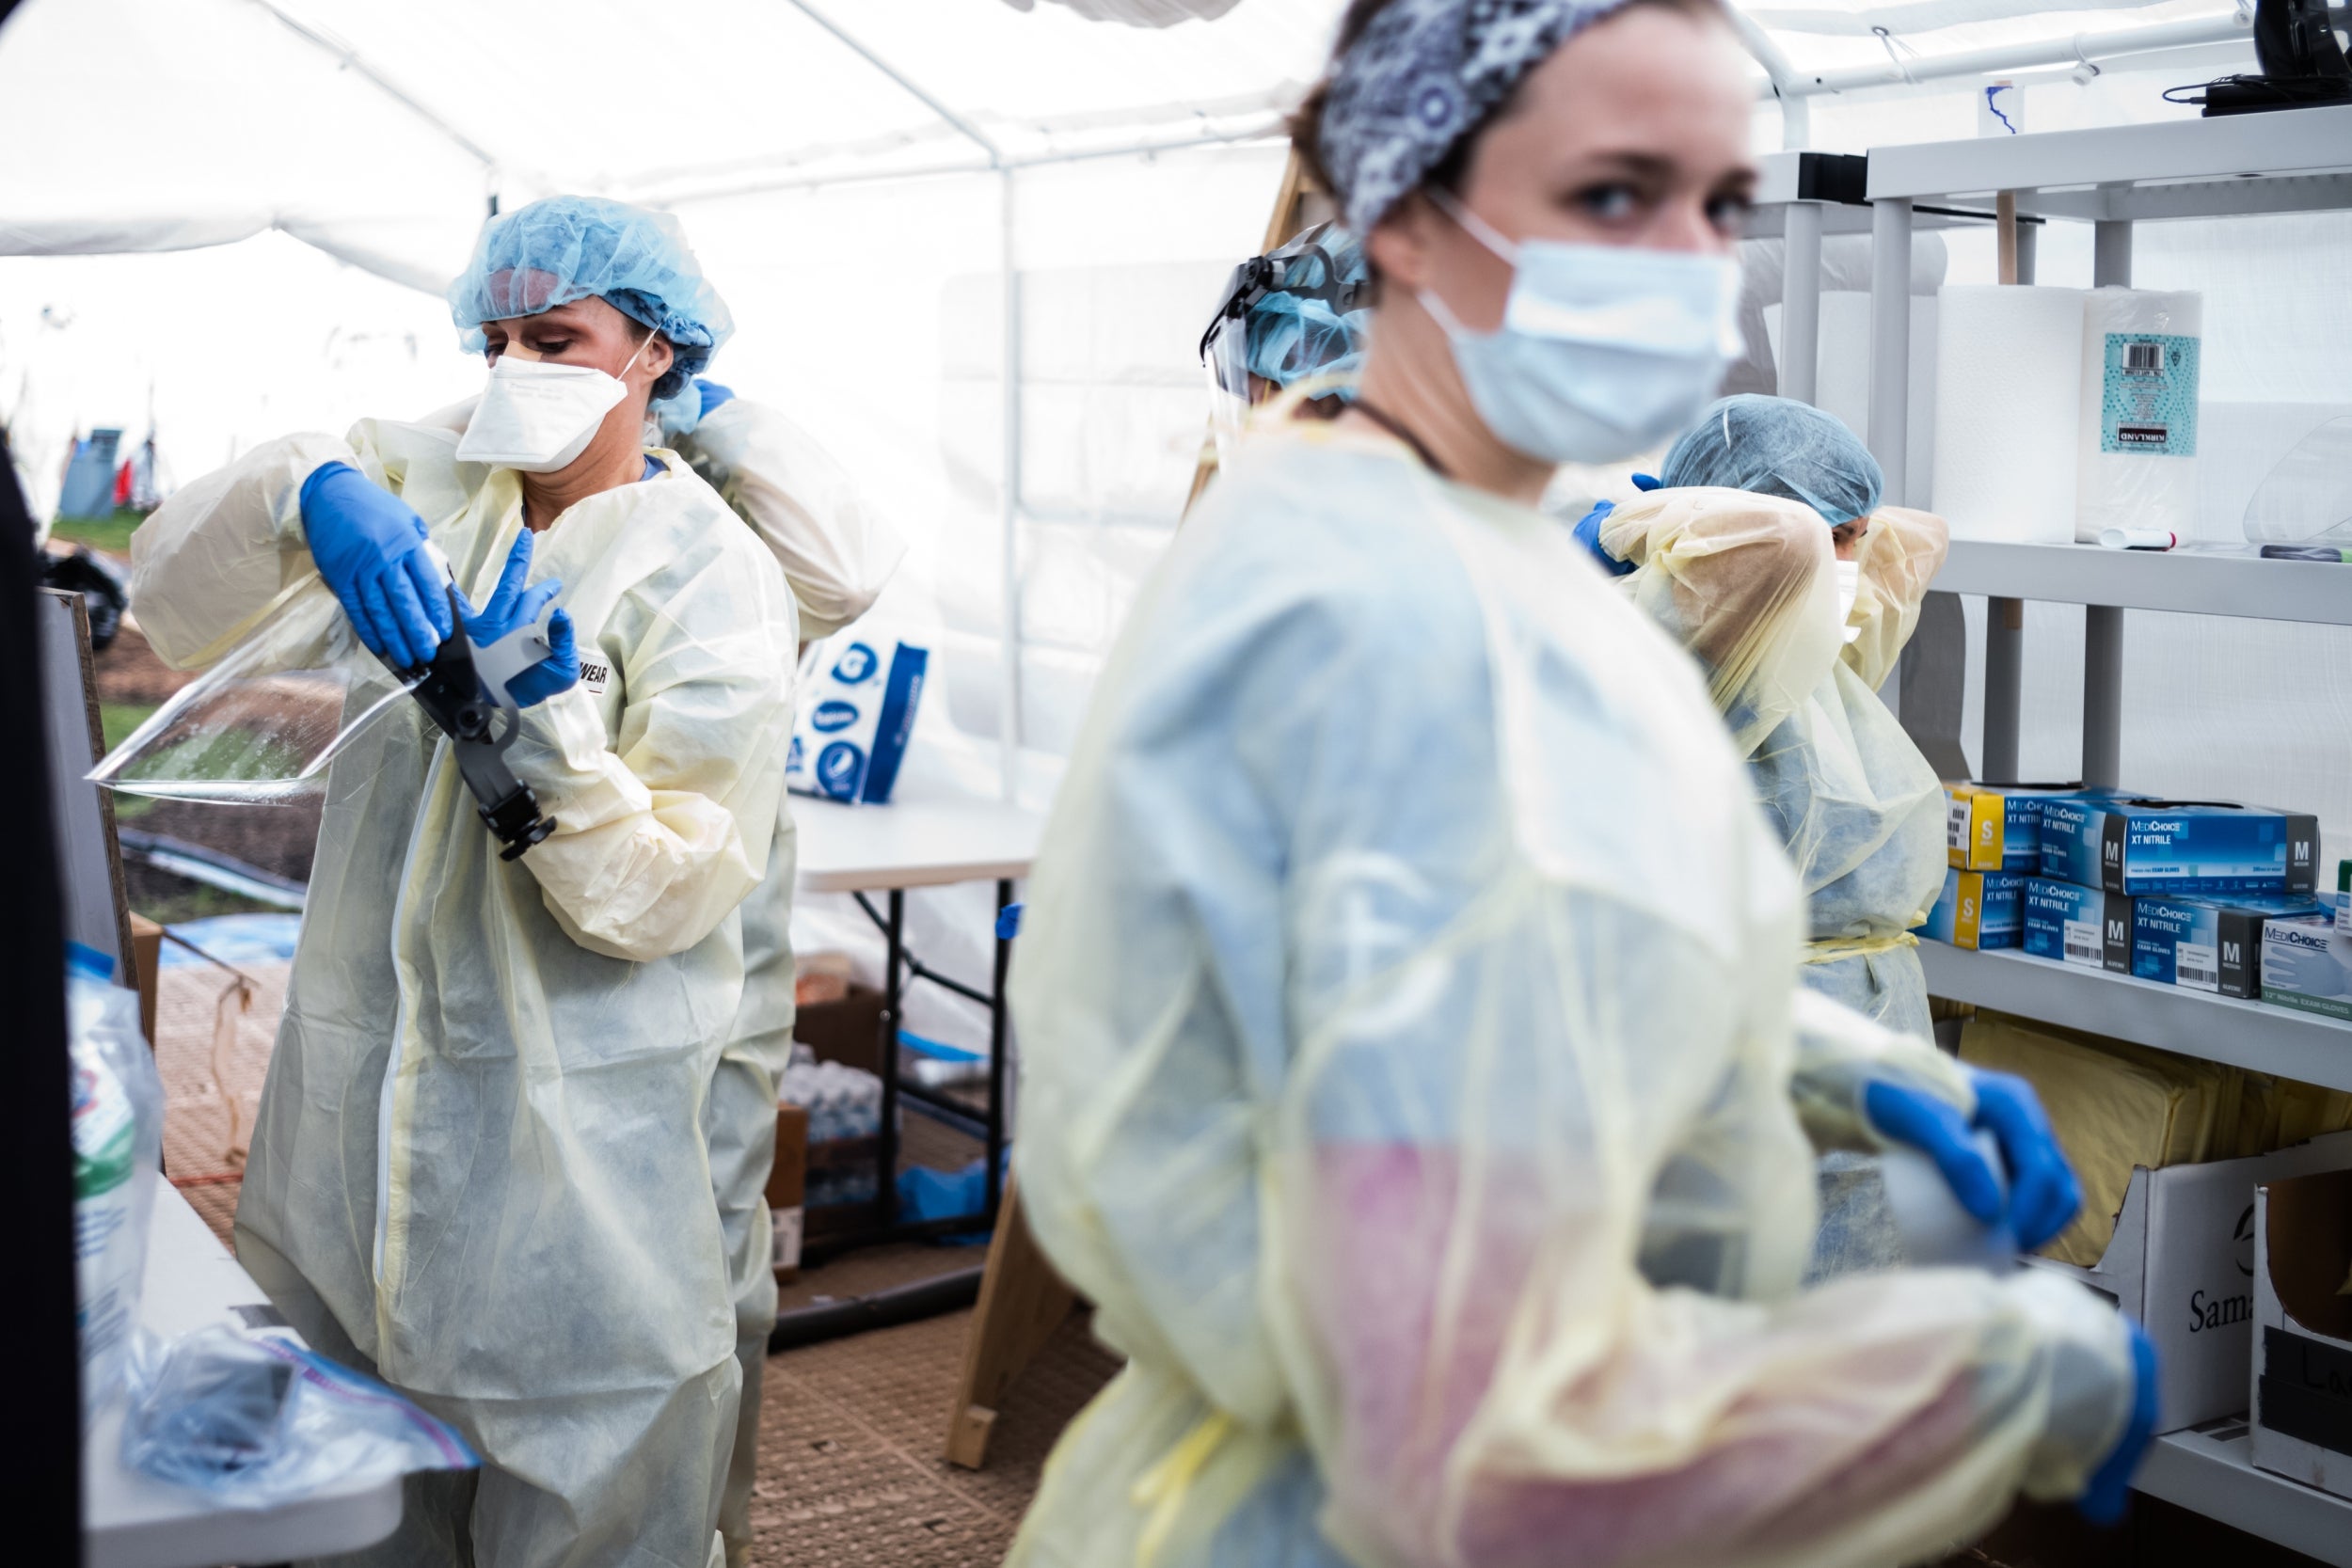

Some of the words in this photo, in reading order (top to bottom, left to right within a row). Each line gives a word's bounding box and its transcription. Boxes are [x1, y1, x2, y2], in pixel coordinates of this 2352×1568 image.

[2121, 433, 2165, 442] KIRKLAND
[2043, 805, 2085, 823] MEDICHOICE
[1981, 819, 1993, 840] S
[2042, 818, 2052, 829] XT
[2052, 820, 2076, 834] NITRILE
[2131, 820, 2181, 832] MEDICHOICE
[2131, 834, 2141, 845] XT
[2143, 834, 2171, 845] NITRILE
[2106, 840, 2119, 862] M
[2295, 841, 2309, 861] M
[2028, 881, 2080, 901] MEDICHOICE
[1963, 897, 1974, 917] S
[2028, 895, 2039, 906] XT
[2040, 897, 2070, 912] NITRILE
[2137, 902, 2192, 922] MEDICHOICE
[2107, 919, 2124, 941] M
[2137, 916, 2148, 927] XT
[2150, 919, 2181, 934] NITRILE
[2265, 926, 2328, 949] MEDICHOICE
[2222, 941, 2240, 963] M
[2300, 998, 2321, 1008] EXAM
[2322, 1003, 2349, 1015] GLOVES
